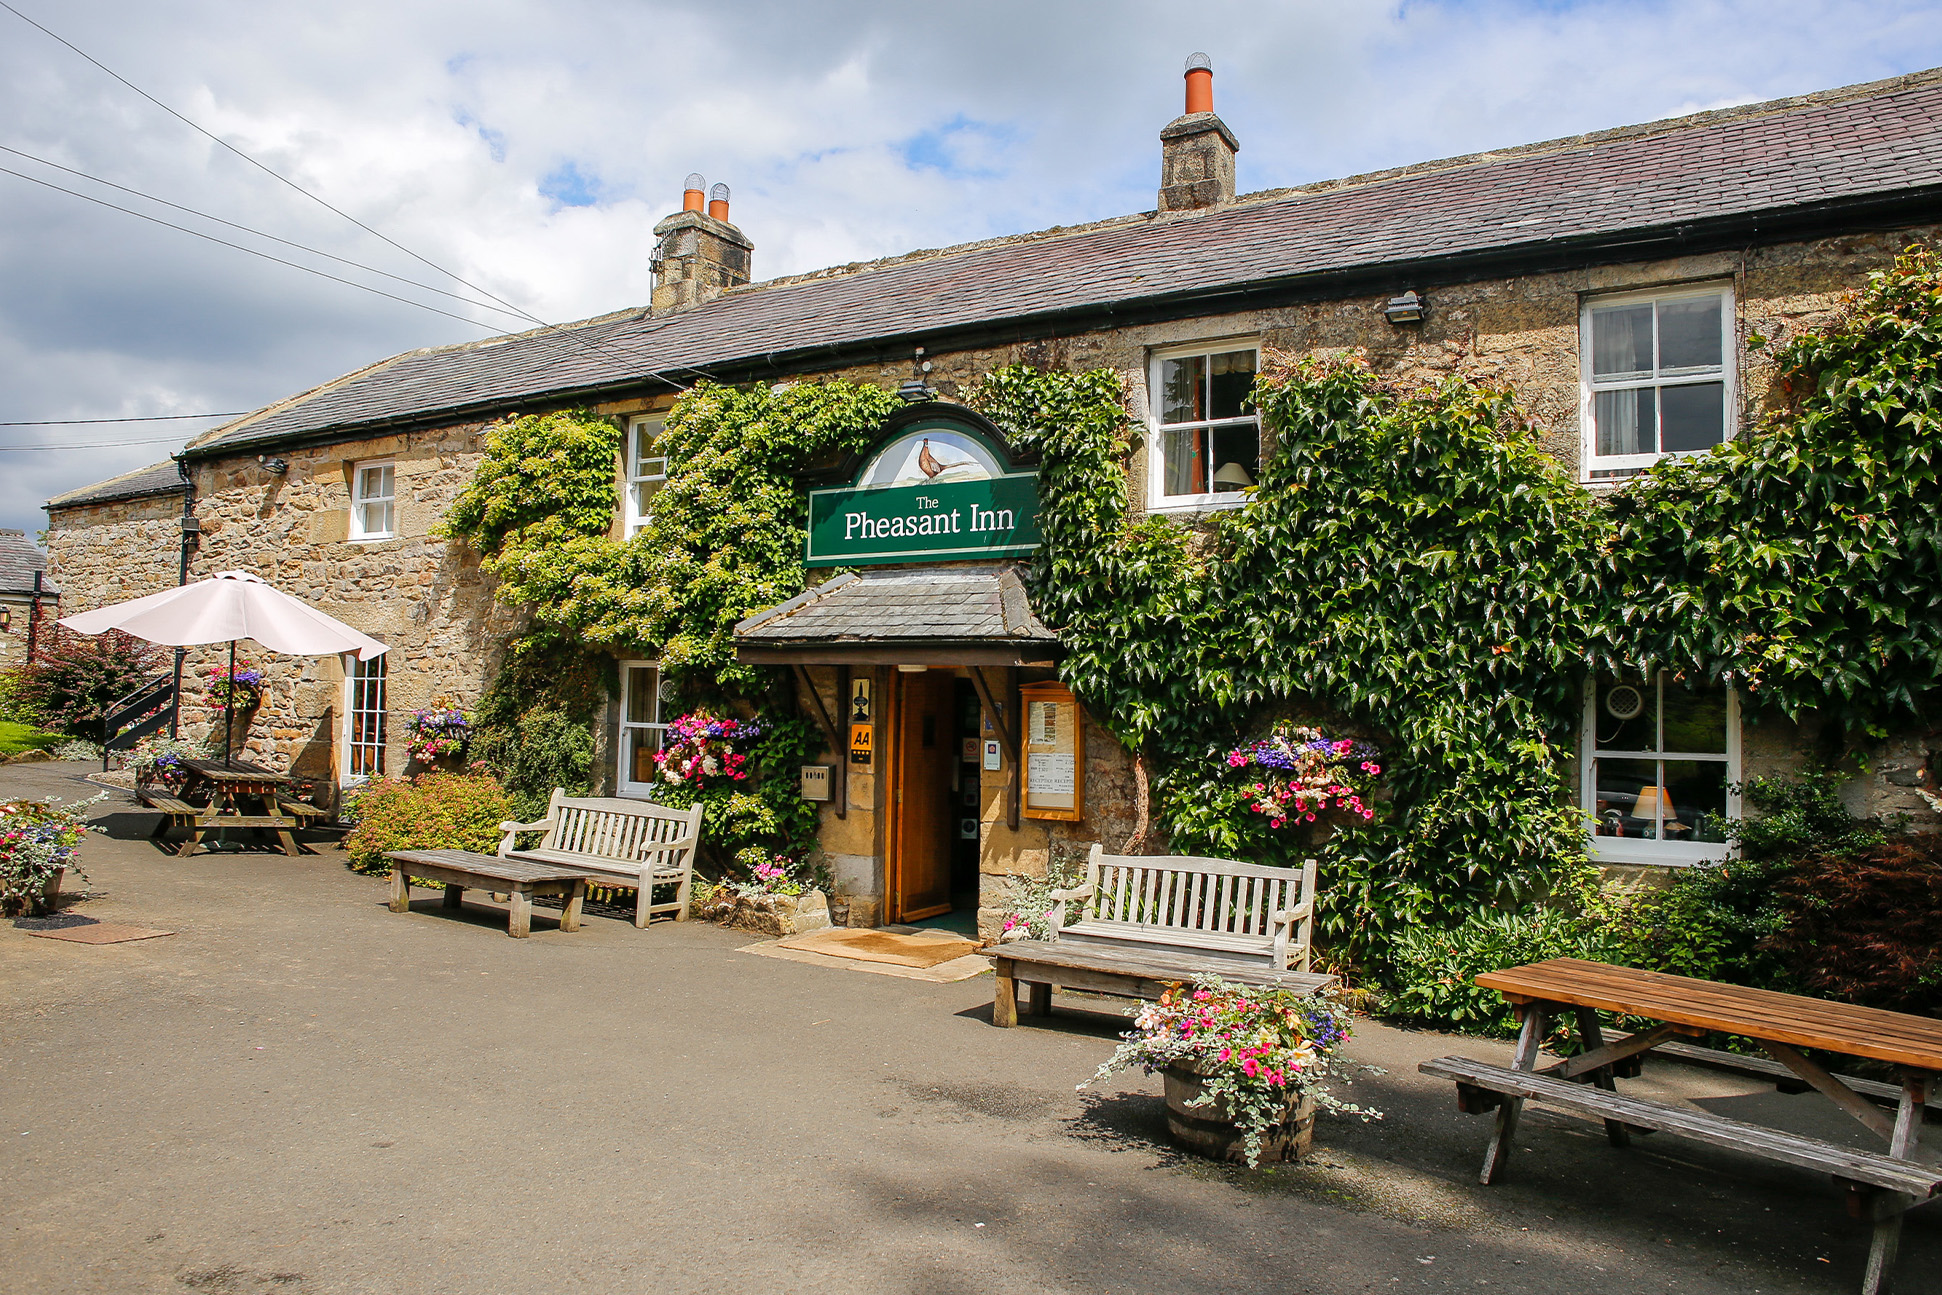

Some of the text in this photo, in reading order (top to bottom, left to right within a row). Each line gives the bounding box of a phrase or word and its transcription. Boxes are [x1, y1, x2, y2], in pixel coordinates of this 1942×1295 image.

[916, 496, 939, 510] The
[844, 503, 1015, 540] Pheasant Inn
[853, 731, 870, 746] AA
